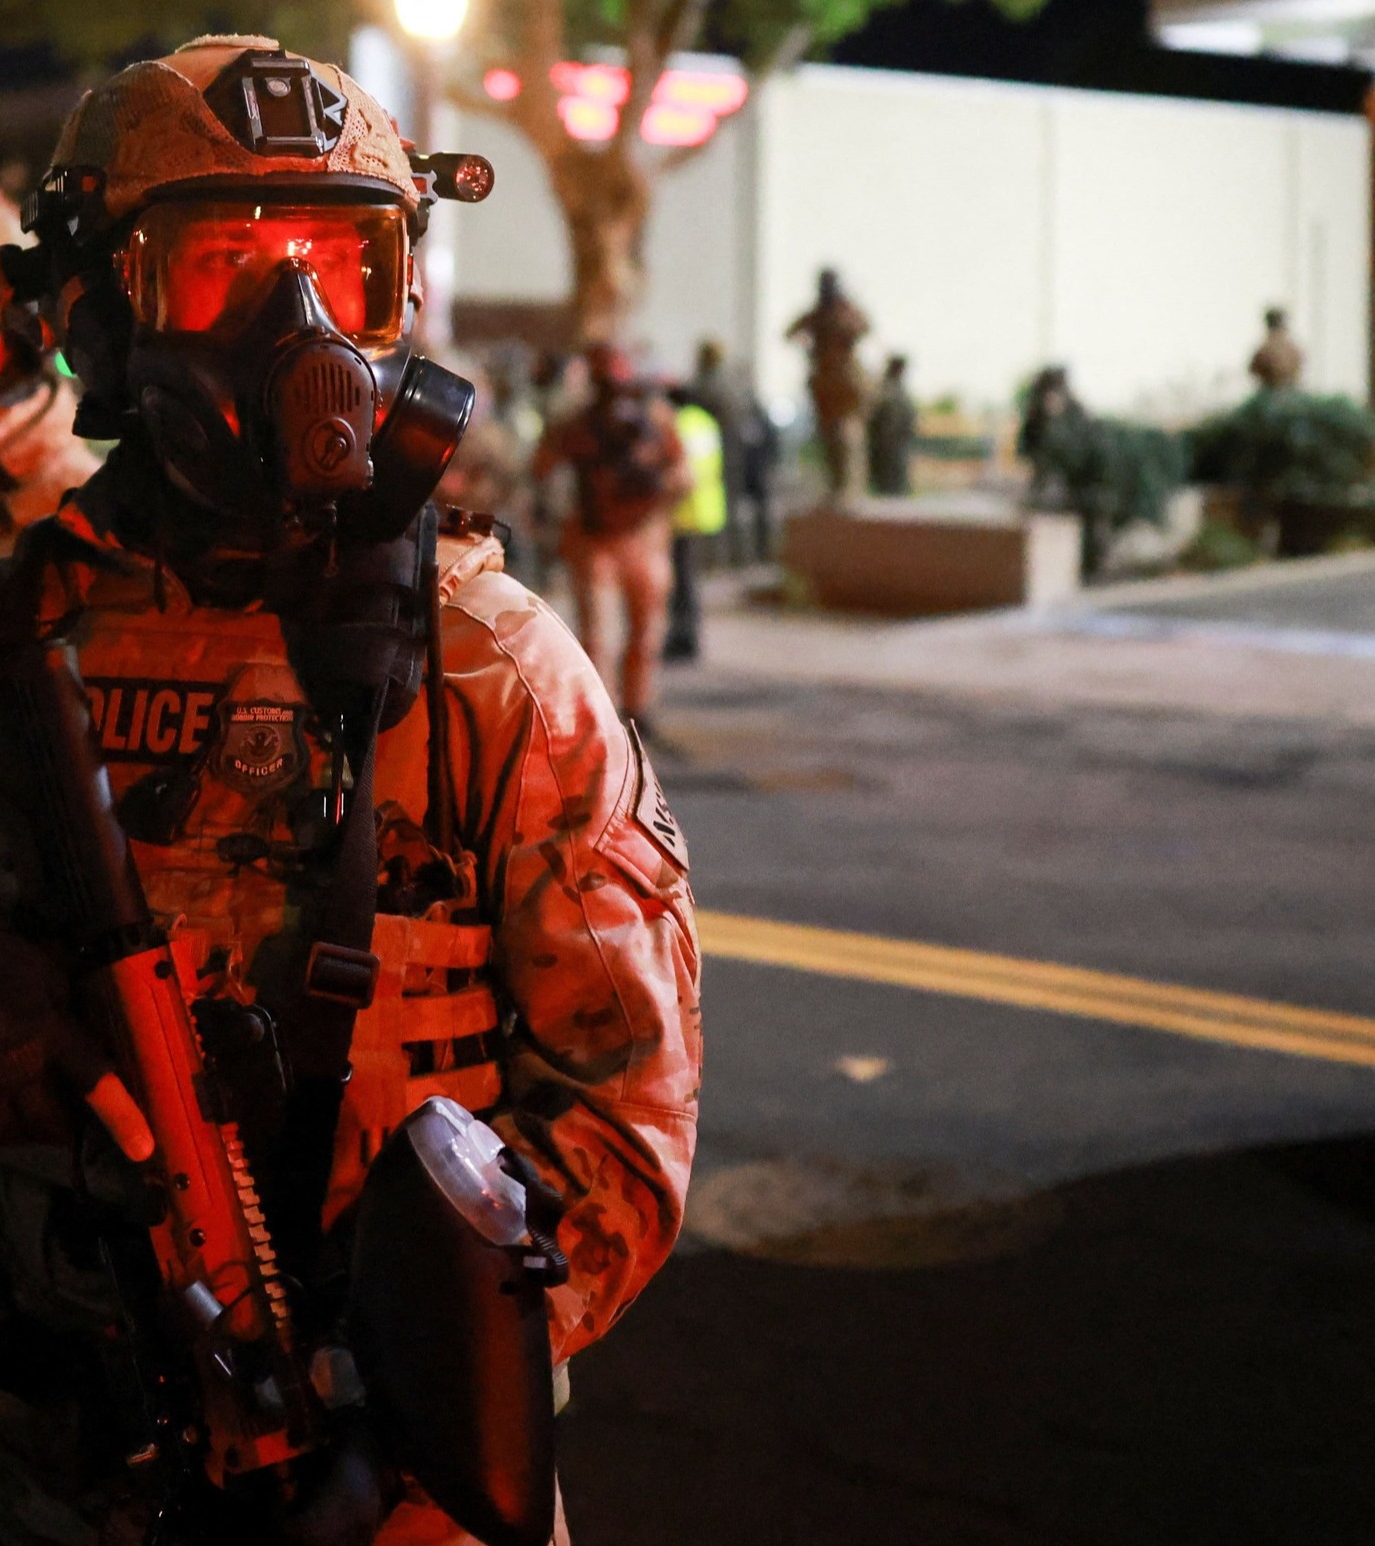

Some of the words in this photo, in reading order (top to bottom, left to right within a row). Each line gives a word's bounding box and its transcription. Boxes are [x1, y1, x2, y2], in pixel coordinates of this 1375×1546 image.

[250, 706, 282, 715] CUSTOMS
[85, 686, 214, 754] LICE
[255, 714, 294, 722] PROTECTION
[235, 758, 283, 776] OFFICER
